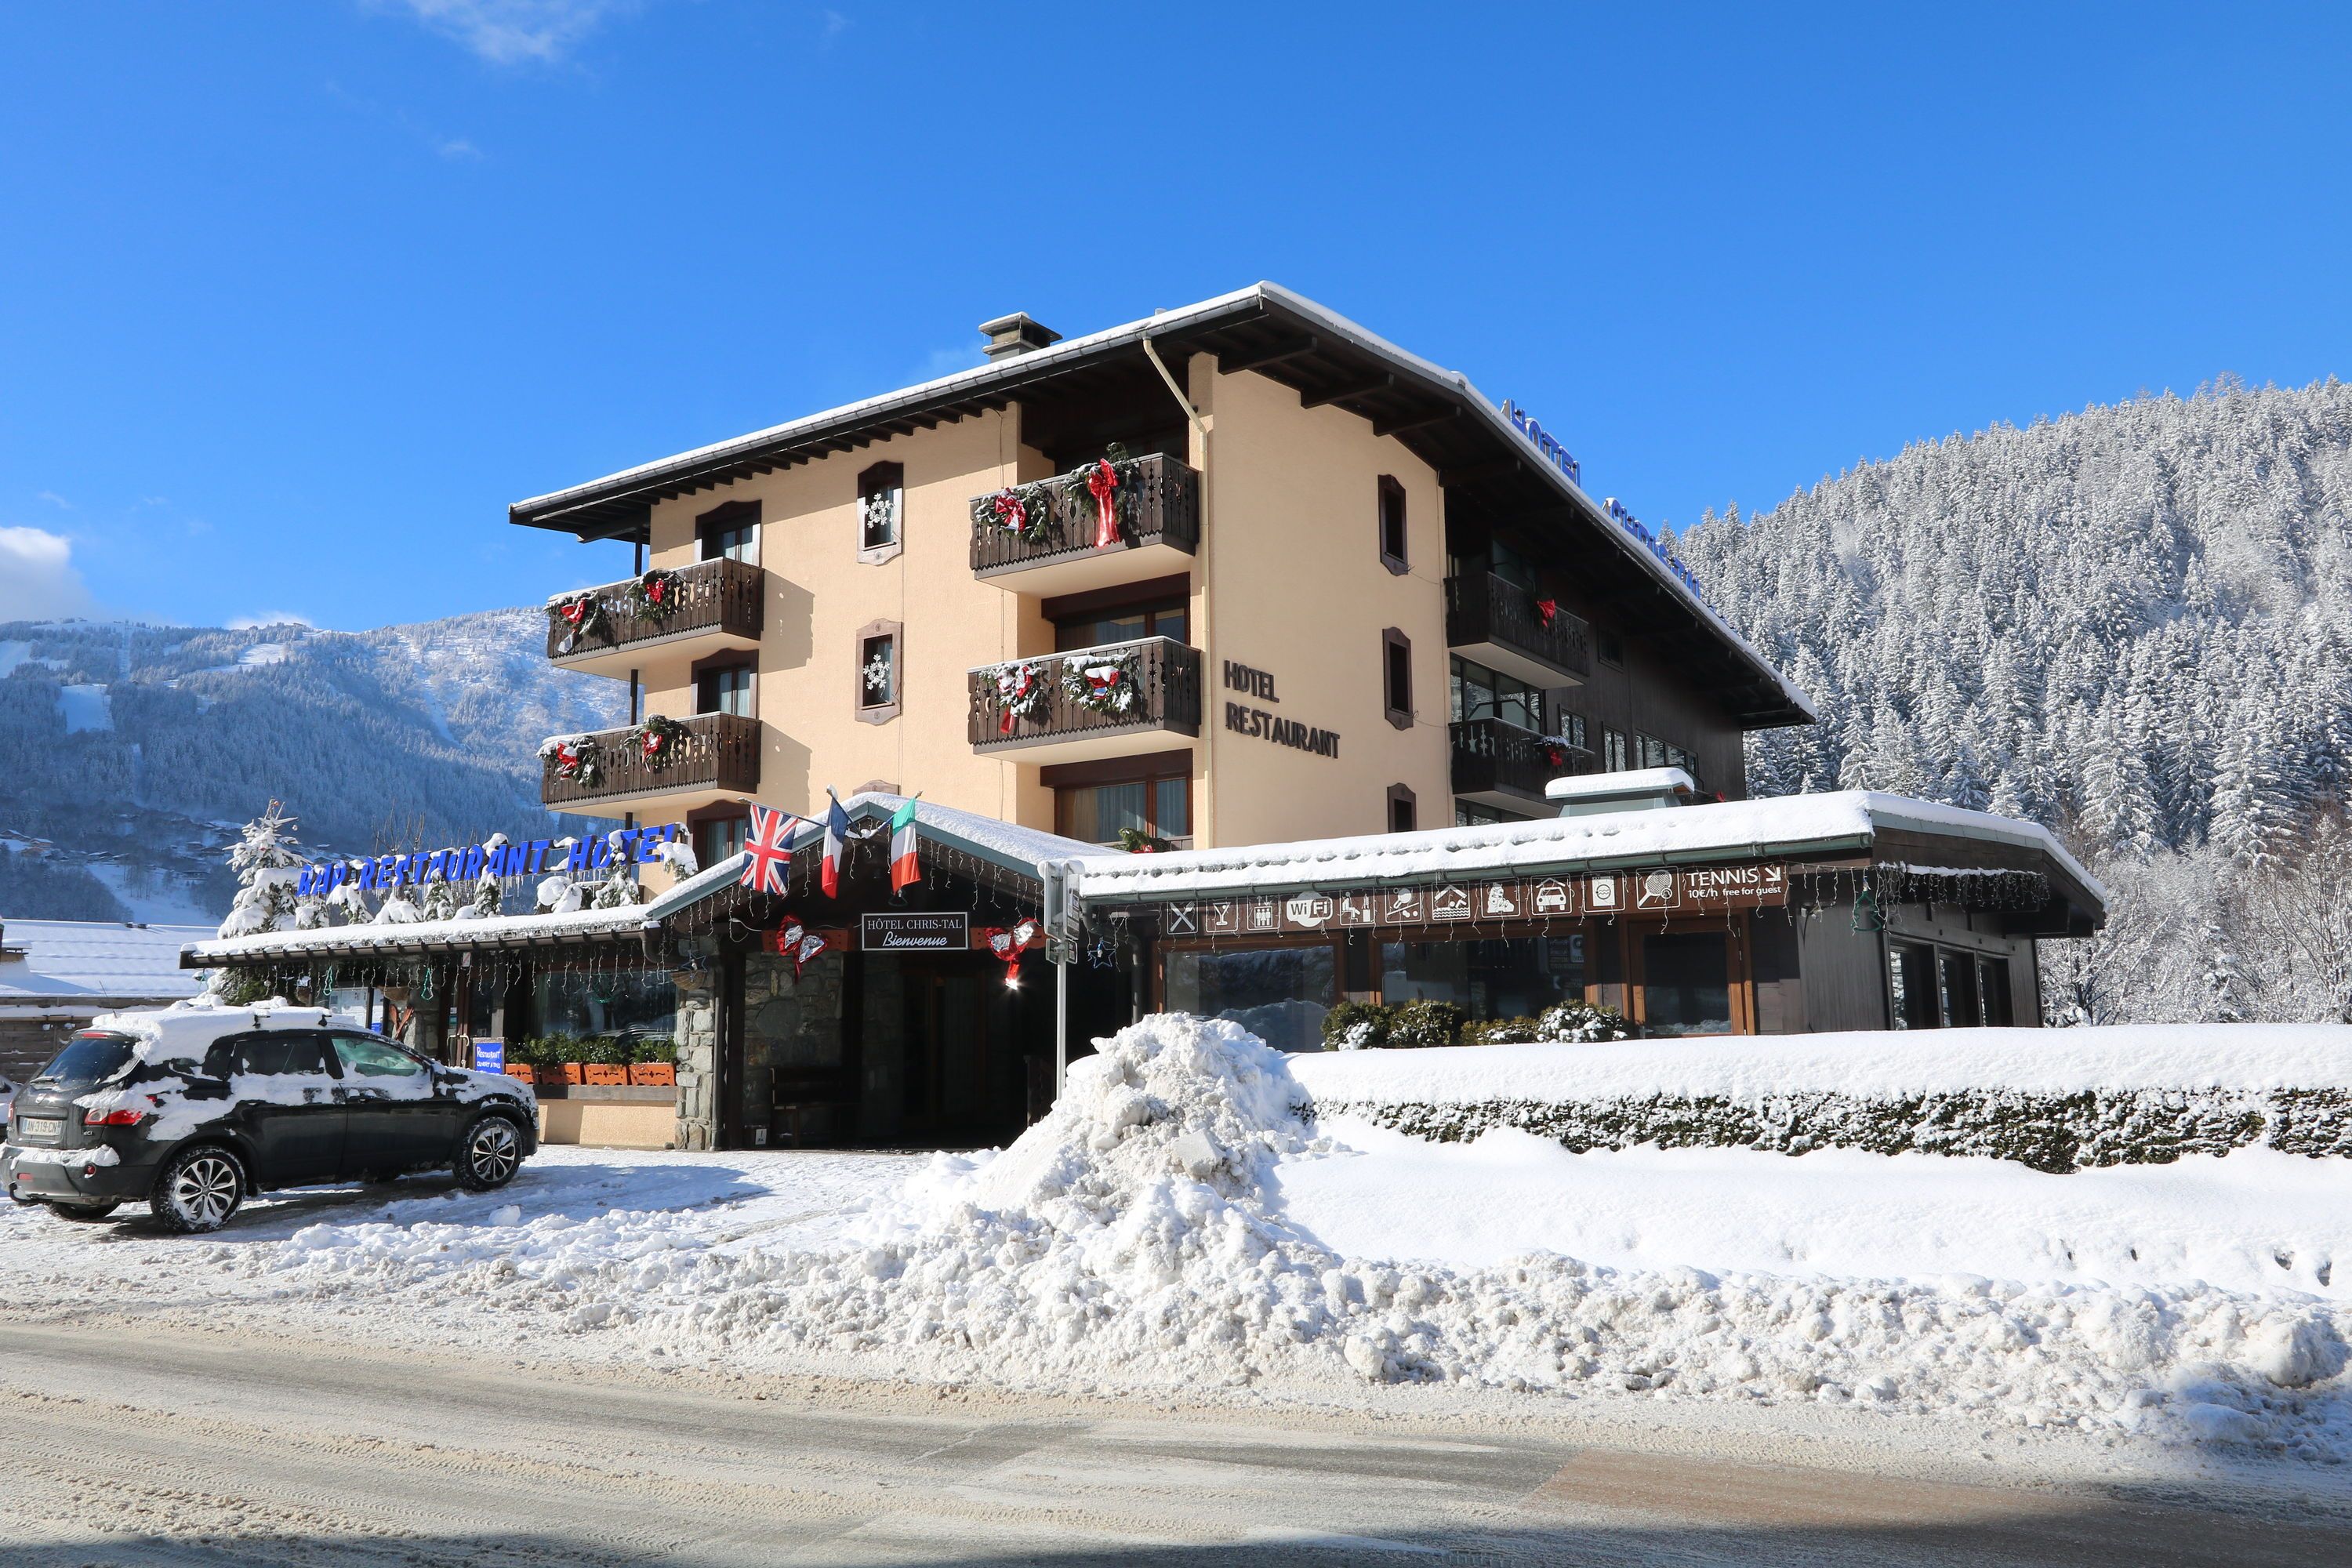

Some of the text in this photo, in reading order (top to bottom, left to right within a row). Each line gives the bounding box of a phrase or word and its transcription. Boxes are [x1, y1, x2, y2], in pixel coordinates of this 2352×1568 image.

[1224, 660, 1279, 703] HOTEL
[1225, 702, 1341, 759] RESTAURANT
[358, 839, 552, 891] RESTAURANT
[1686, 868, 1759, 887] TENNIS
[1688, 888, 1719, 898] 10€/h
[1741, 887, 1755, 895] for
[1756, 886, 1781, 896] guest
[868, 918, 963, 930] HÔTEL CHRIS-TAL
[883, 931, 948, 947] Bienvenue
